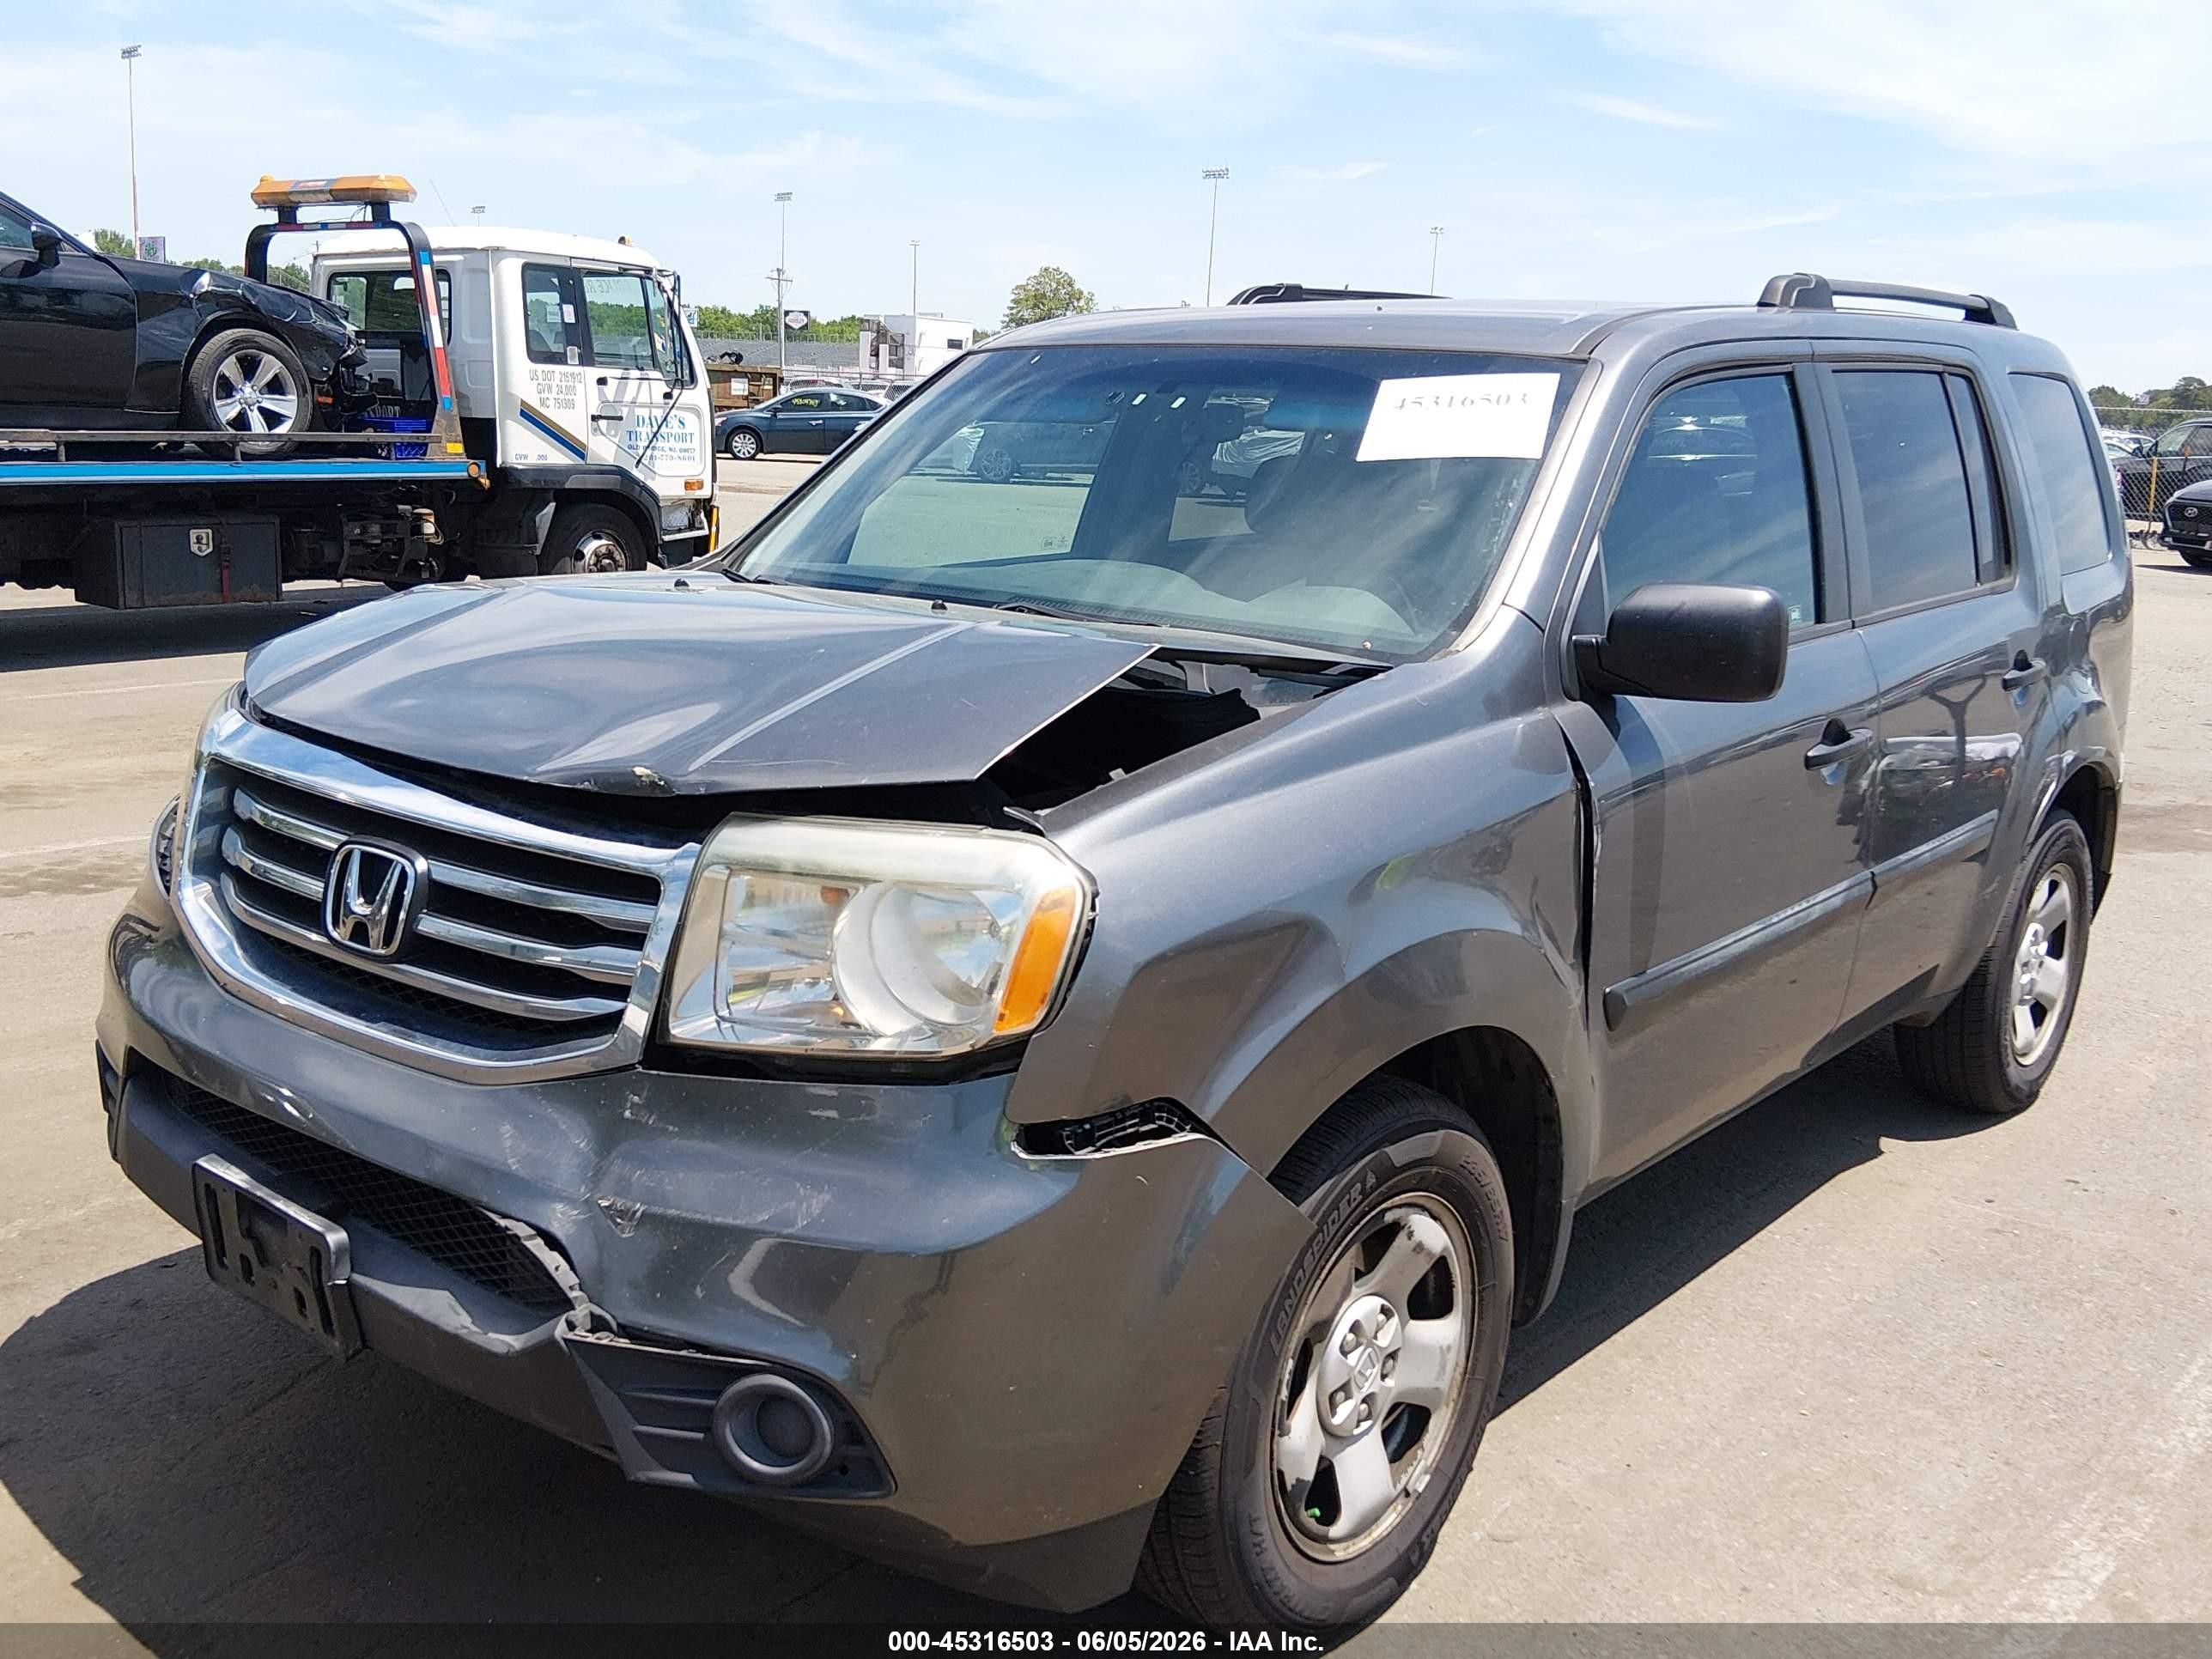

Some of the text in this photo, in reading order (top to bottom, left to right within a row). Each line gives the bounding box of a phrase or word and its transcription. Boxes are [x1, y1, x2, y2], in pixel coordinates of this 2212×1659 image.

[529, 369, 539, 381] US
[542, 370, 555, 382] DOT
[537, 383, 576, 397] GVW 24,000
[540, 397, 575, 410] MC 751309
[636, 415, 685, 429] DAVE'S
